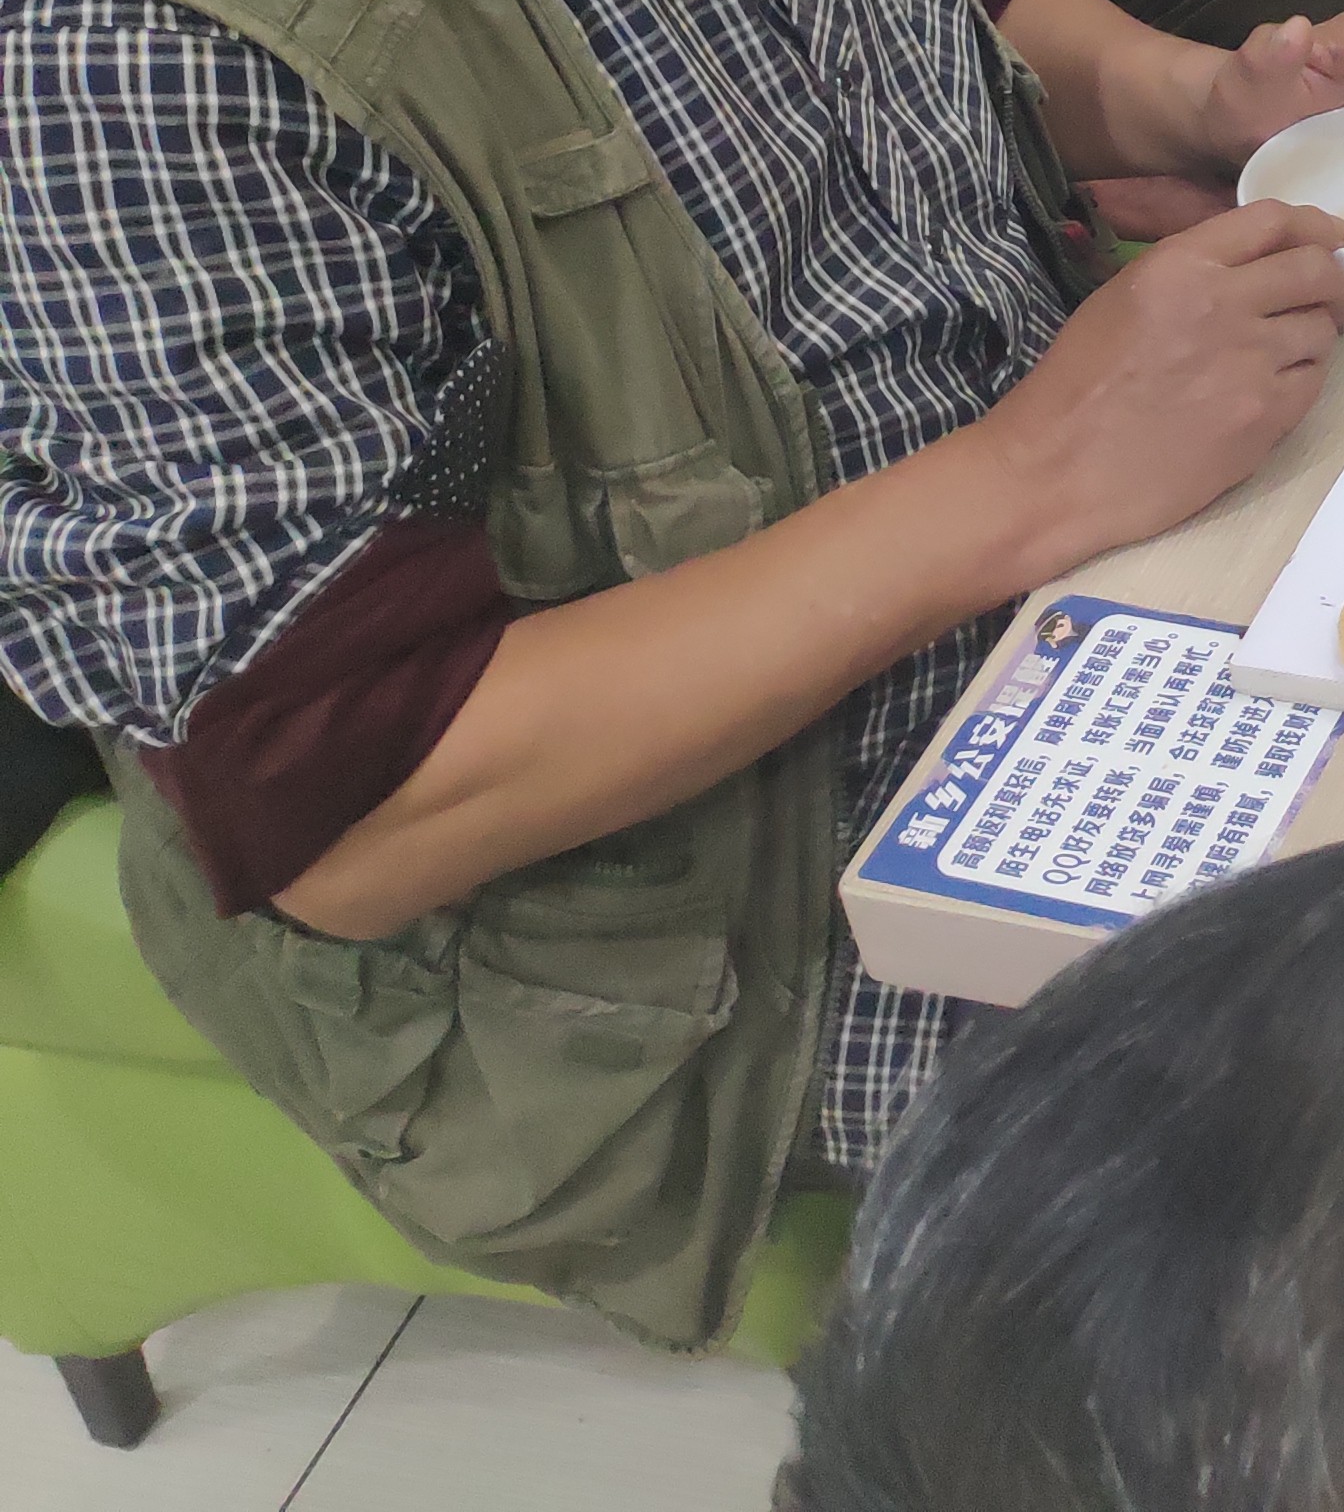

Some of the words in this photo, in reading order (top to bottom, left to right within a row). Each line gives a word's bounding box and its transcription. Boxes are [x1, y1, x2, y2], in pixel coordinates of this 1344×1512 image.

[898, 653, 1060, 849] 新乡公安提醒
[1084, 652, 1235, 897] 网络放贷多骗局，合法贷款要
